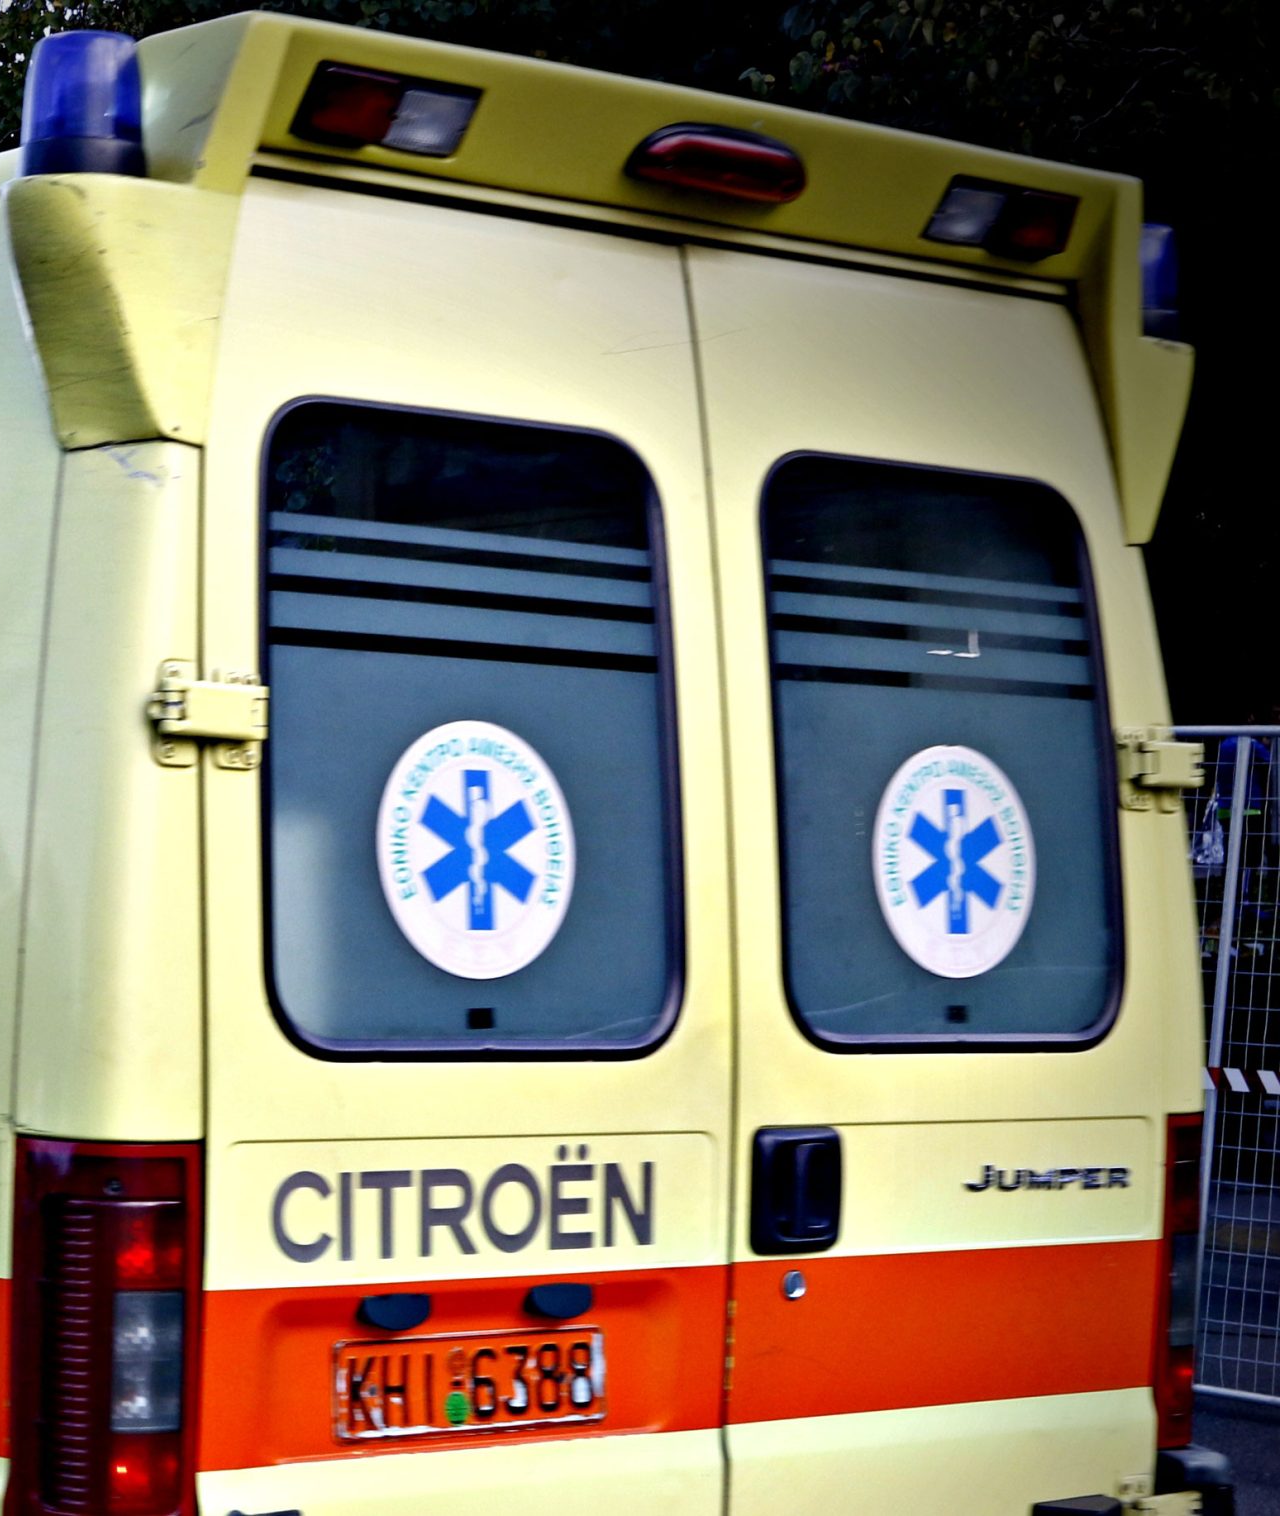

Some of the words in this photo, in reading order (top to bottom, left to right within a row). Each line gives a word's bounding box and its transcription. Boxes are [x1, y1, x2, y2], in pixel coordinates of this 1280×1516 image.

[271, 1143, 656, 1264] CITROËN
[963, 1163, 1133, 1192] JUMPER
[472, 1341, 593, 1418] 6388
